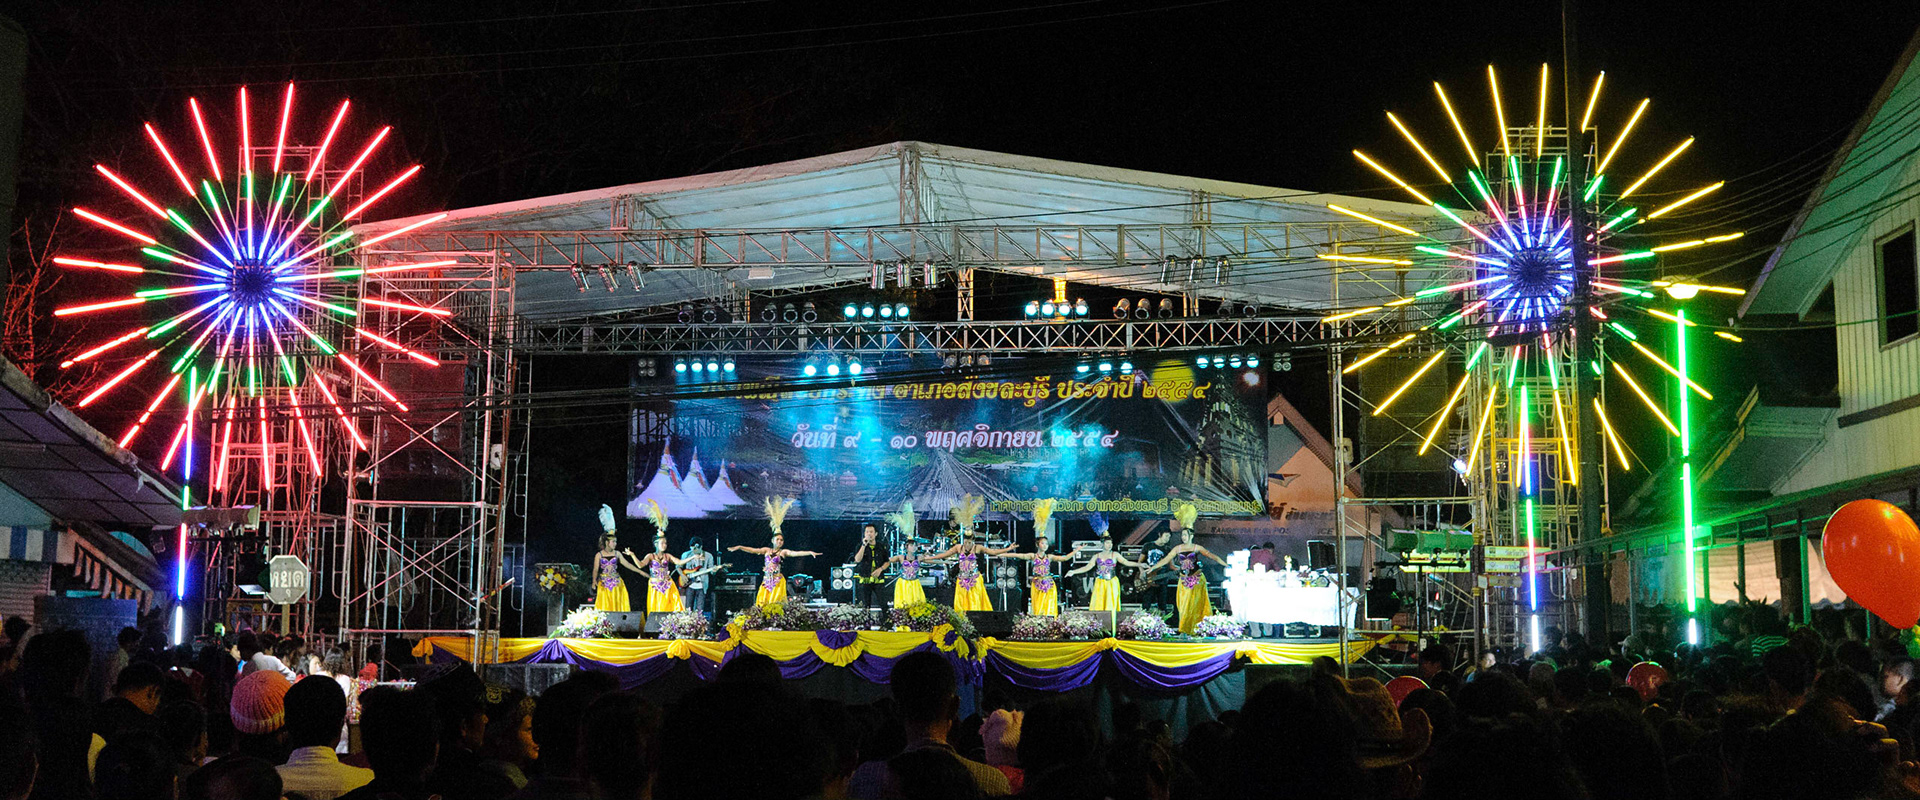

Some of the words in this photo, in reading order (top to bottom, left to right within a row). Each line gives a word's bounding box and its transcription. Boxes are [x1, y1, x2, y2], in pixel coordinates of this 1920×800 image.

[1057, 374, 1136, 399] ประจำปี
[1142, 381, 1212, 399] ๒๕๕๔
[791, 417, 838, 449] วันที่
[843, 431, 862, 448] ๙
[890, 435, 918, 449] ๑๐
[925, 423, 1043, 453] พฤศจิกายน
[1050, 430, 1120, 448] ๒๕๕๔
[270, 570, 304, 598] หยุด
